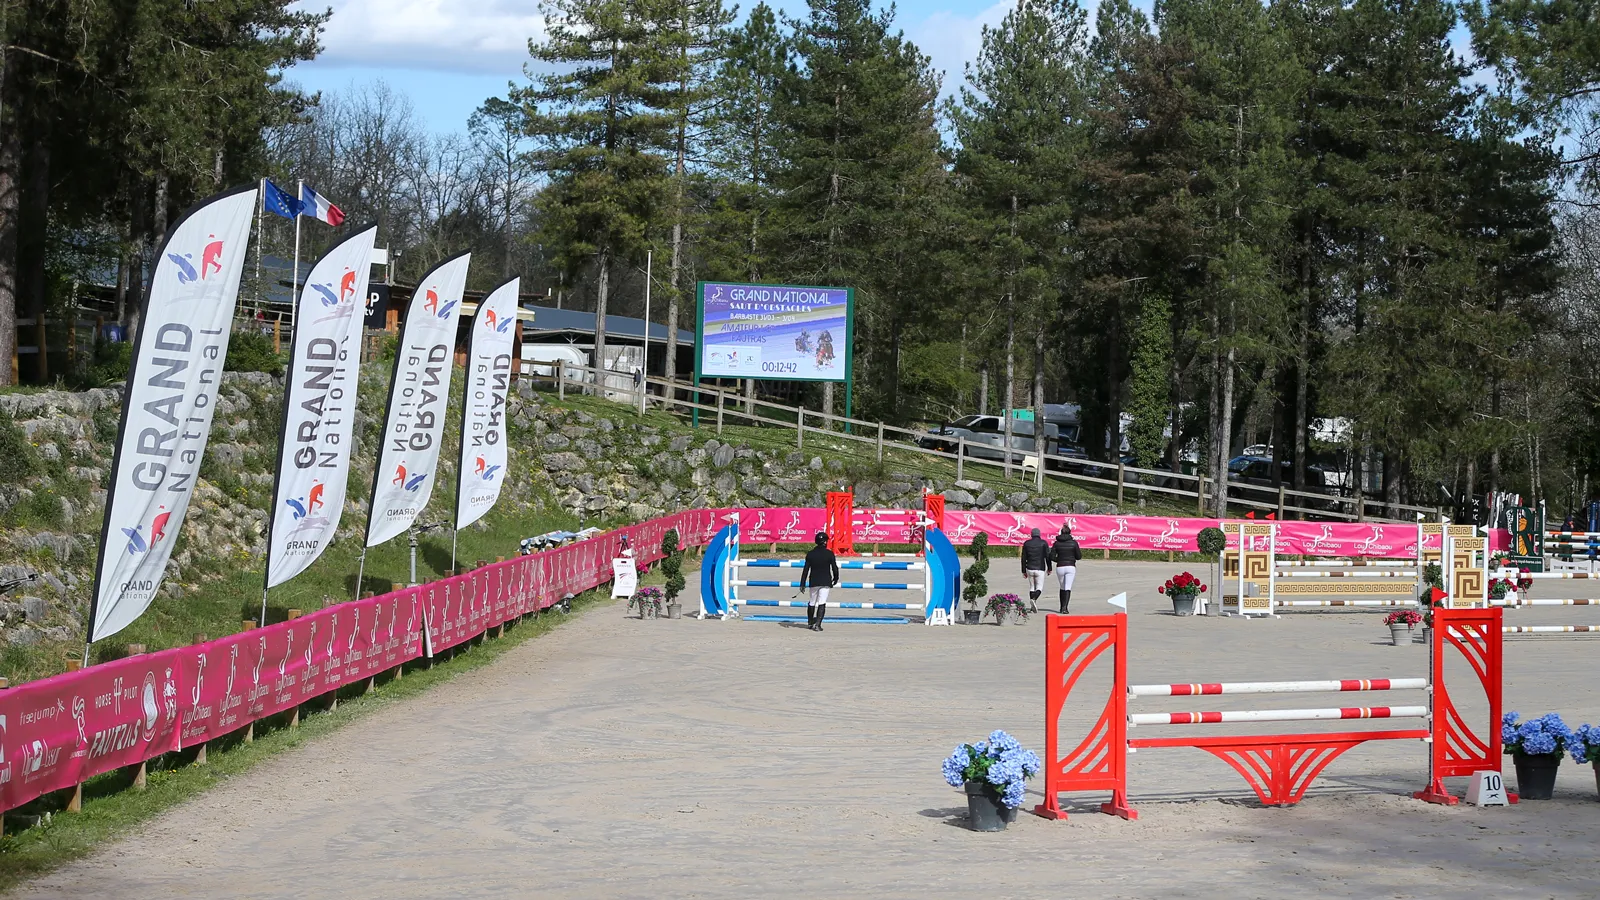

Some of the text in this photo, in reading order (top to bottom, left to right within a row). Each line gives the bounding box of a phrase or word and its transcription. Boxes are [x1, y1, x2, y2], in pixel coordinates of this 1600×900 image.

[730, 288, 770, 302] GRAND
[773, 290, 831, 305] NATIONAL
[730, 302, 752, 311] SAUT
[755, 303, 812, 313] D'OBSTACLES
[730, 312, 759, 320] BARBASTE
[762, 361, 797, 373] 00:12:42
[132, 322, 193, 492] GRAND
[168, 327, 223, 493] National
[295, 337, 337, 470] GRAND
[318, 335, 350, 469] National
[286, 540, 319, 550] GRAND
[935, 610, 943, 618] 11
[94, 686, 138, 709] HORSE PILOT
[20, 706, 56, 726] freejump
[1484, 774, 1501, 792] 10
